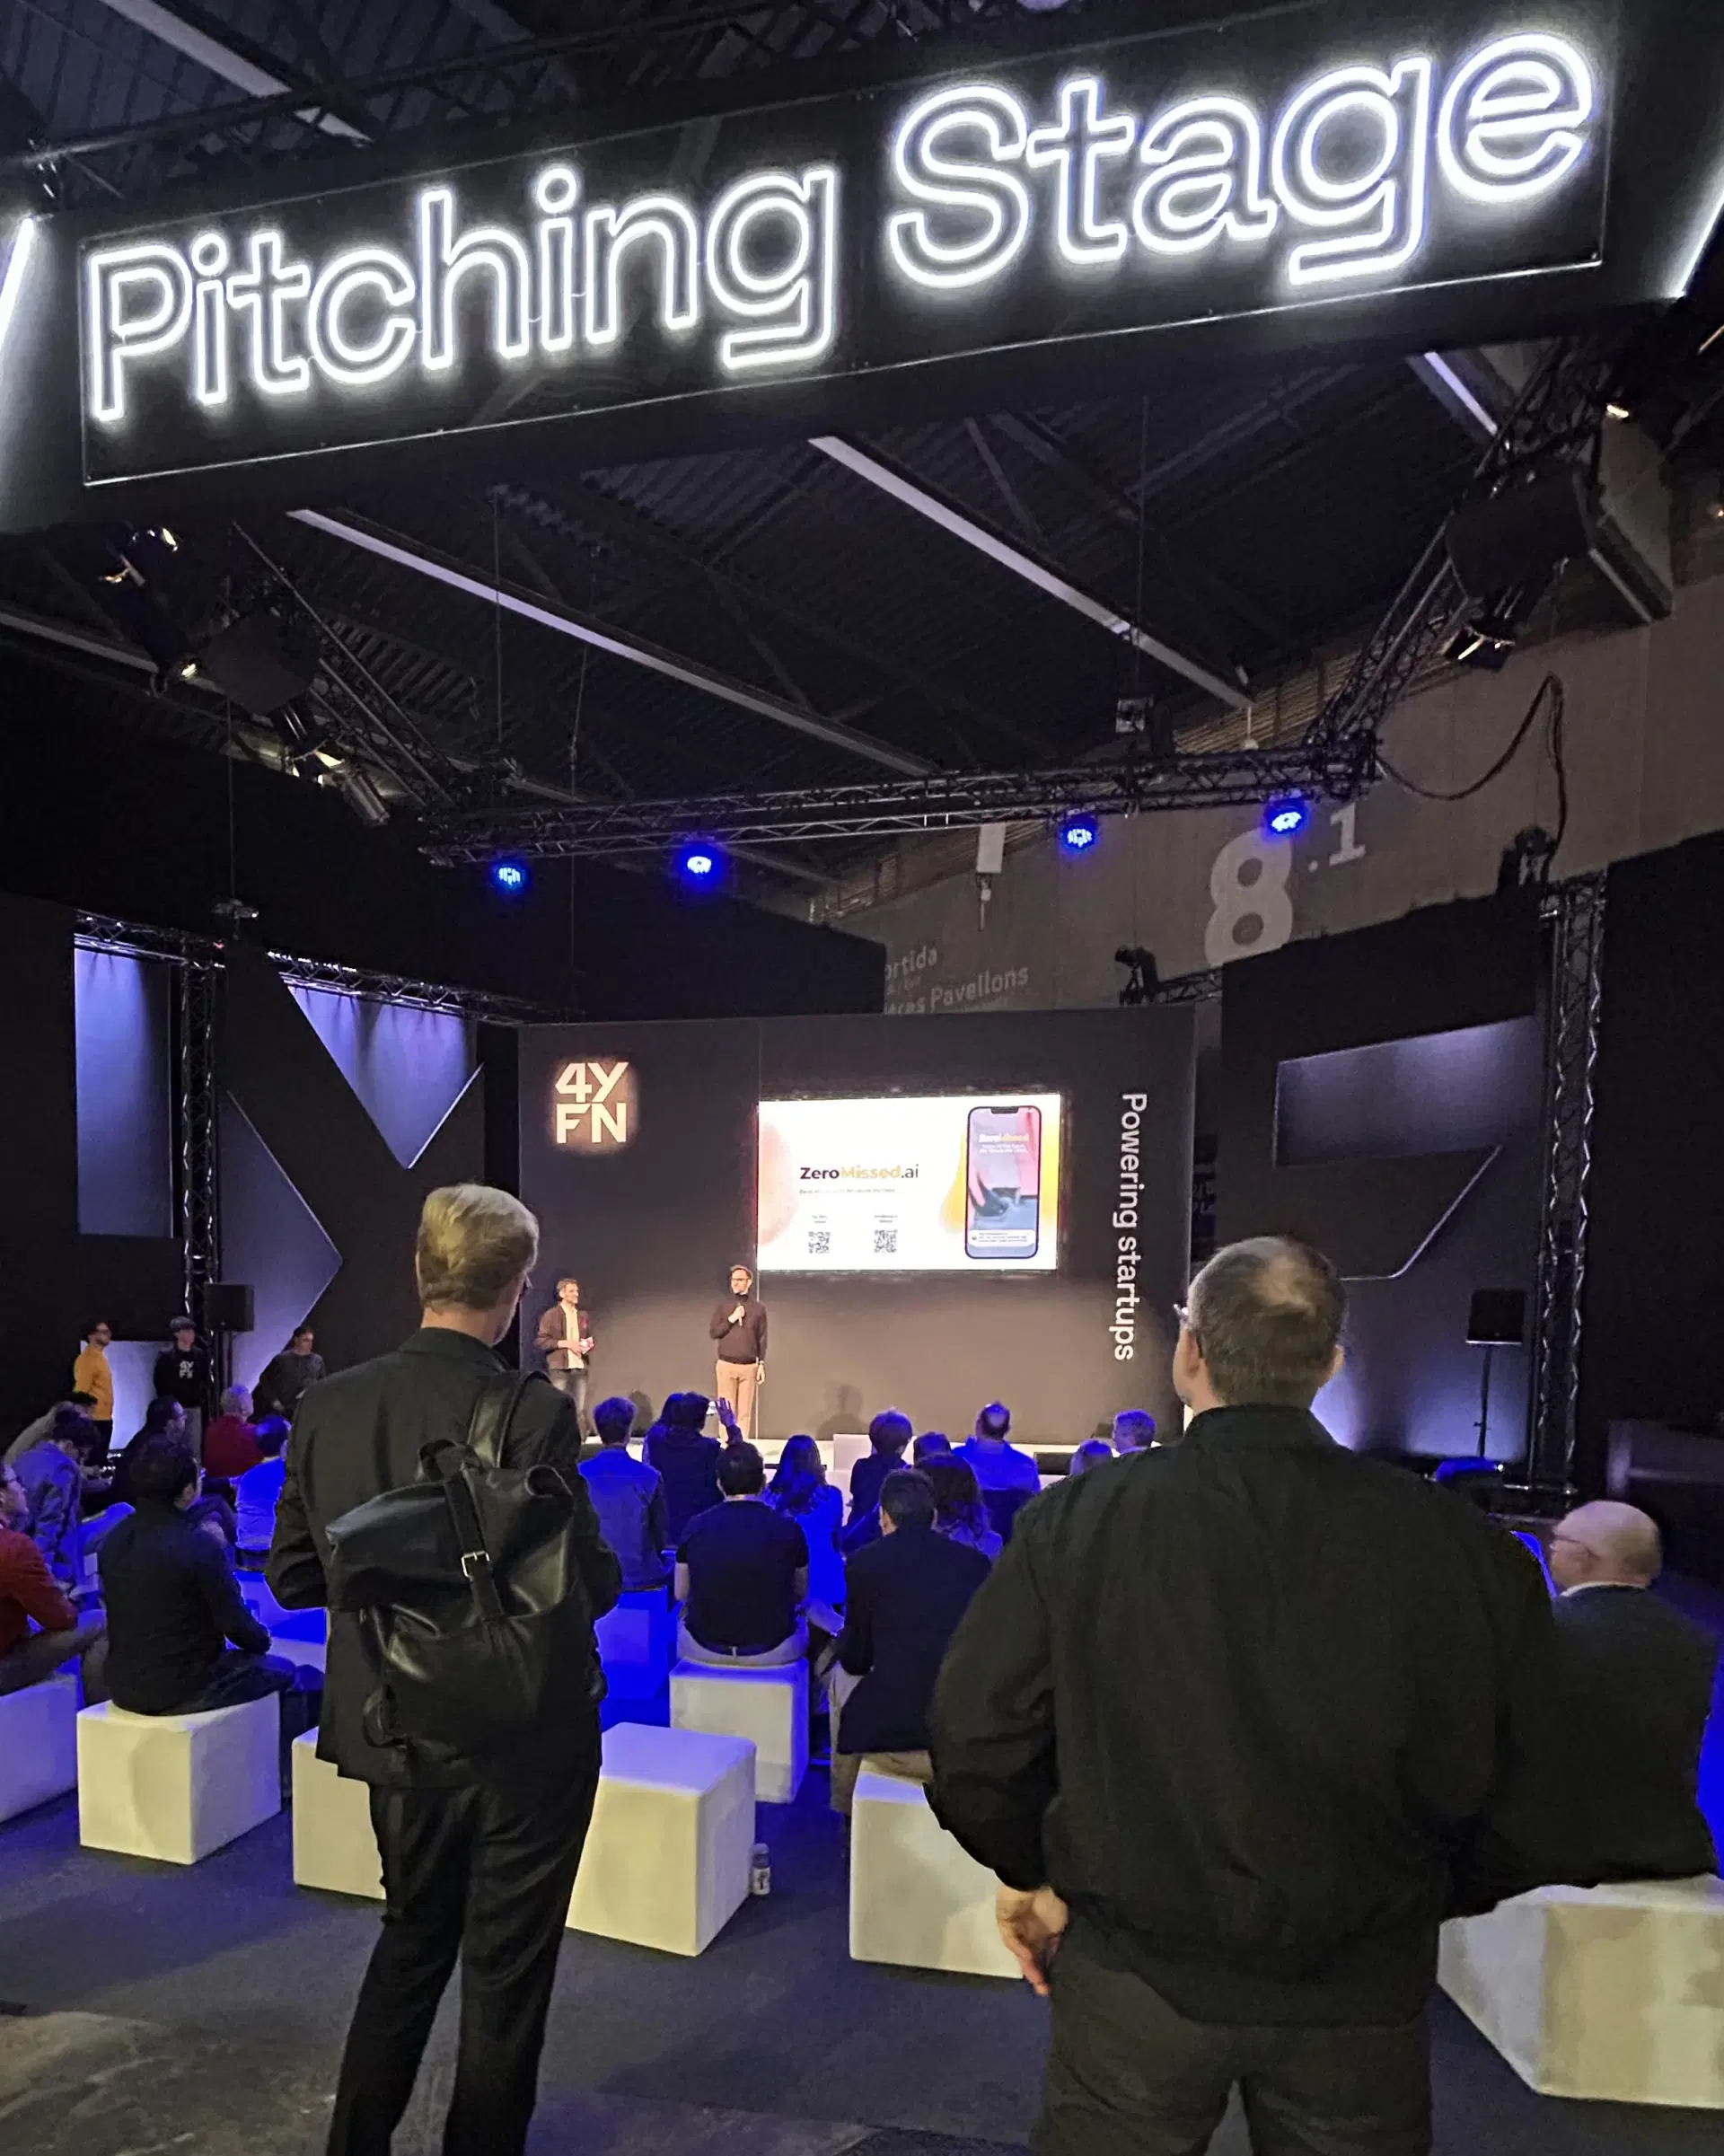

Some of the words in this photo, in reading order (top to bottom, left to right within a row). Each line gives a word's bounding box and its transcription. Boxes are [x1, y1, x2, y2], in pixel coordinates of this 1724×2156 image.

[87, 166, 840, 423] Pitching
[889, 31, 1595, 289] Stage
[1204, 802, 1367, 968] 8.1
[929, 966, 1030, 1013] Pavellons
[555, 1061, 629, 1103] 4Y
[557, 1102, 627, 1143] FN
[800, 1164, 919, 1180] ZeroMissed.ai
[1113, 1093, 1148, 1228] Powering
[1109, 1236, 1142, 1361] startups
